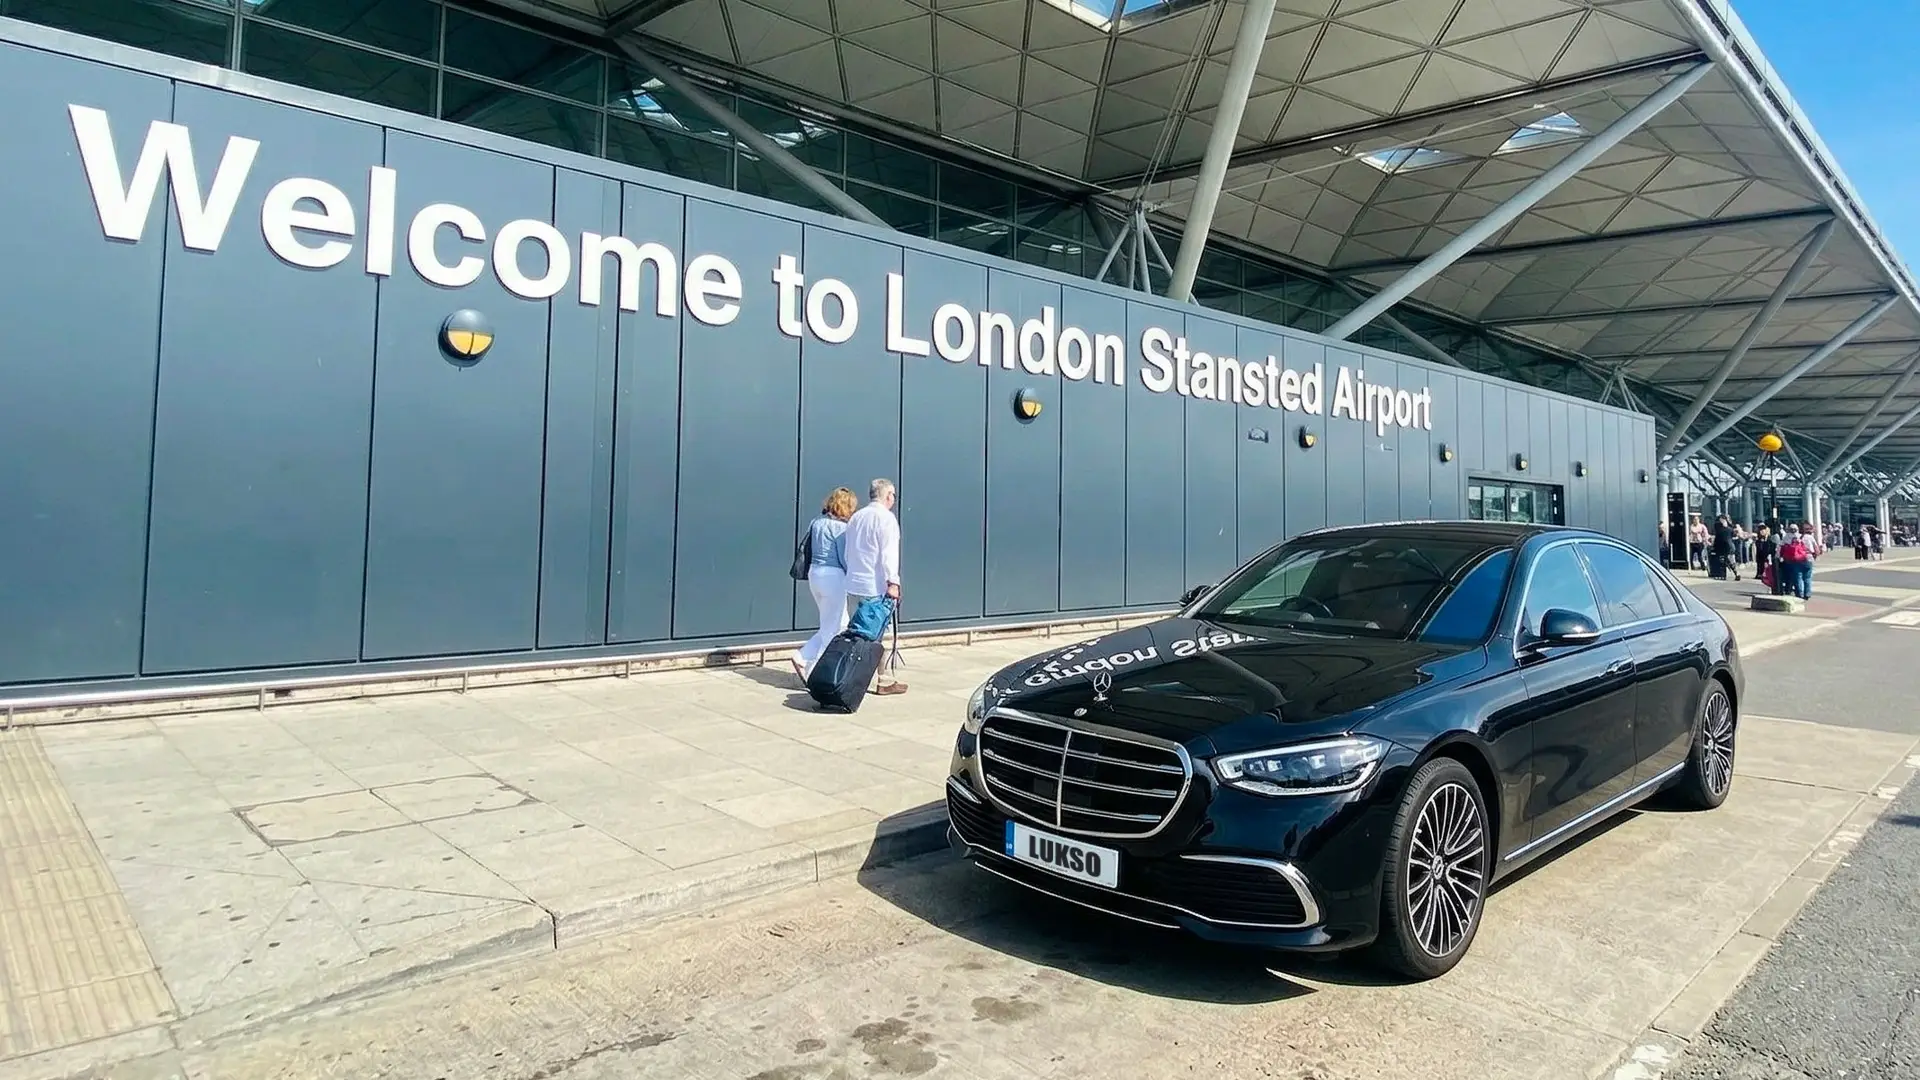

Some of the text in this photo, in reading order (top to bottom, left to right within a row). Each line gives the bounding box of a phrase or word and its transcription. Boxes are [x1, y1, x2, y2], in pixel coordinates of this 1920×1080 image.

[68, 103, 1432, 437] Welcome to London Stansted Airport
[1029, 834, 1101, 878] LUKSO
